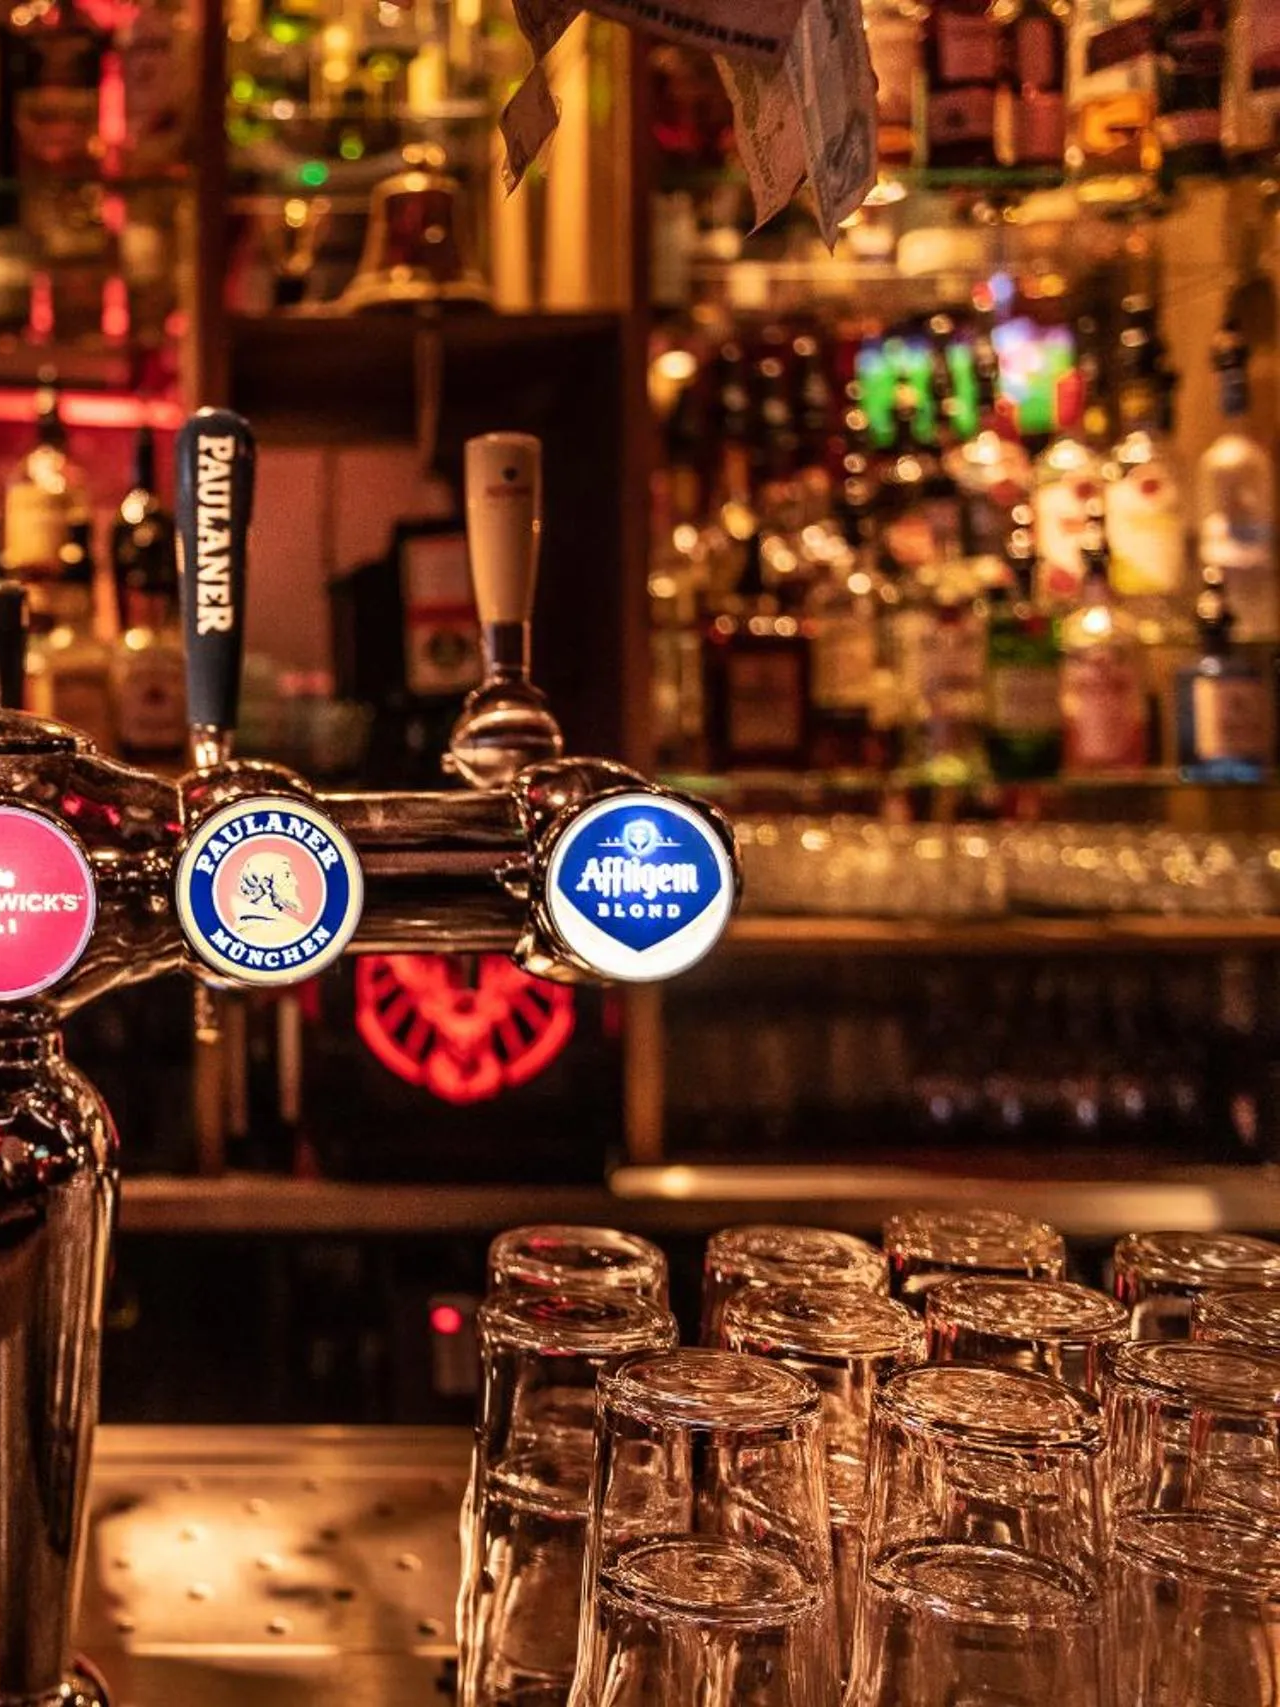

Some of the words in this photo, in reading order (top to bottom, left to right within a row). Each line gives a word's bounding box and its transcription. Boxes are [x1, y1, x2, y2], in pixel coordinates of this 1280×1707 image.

[197, 435, 235, 636] PAULANER
[196, 813, 339, 875] PAULANER
[575, 857, 700, 900] Affligem
[596, 903, 681, 919] BLOND
[209, 925, 331, 966] MÜNCHEN
